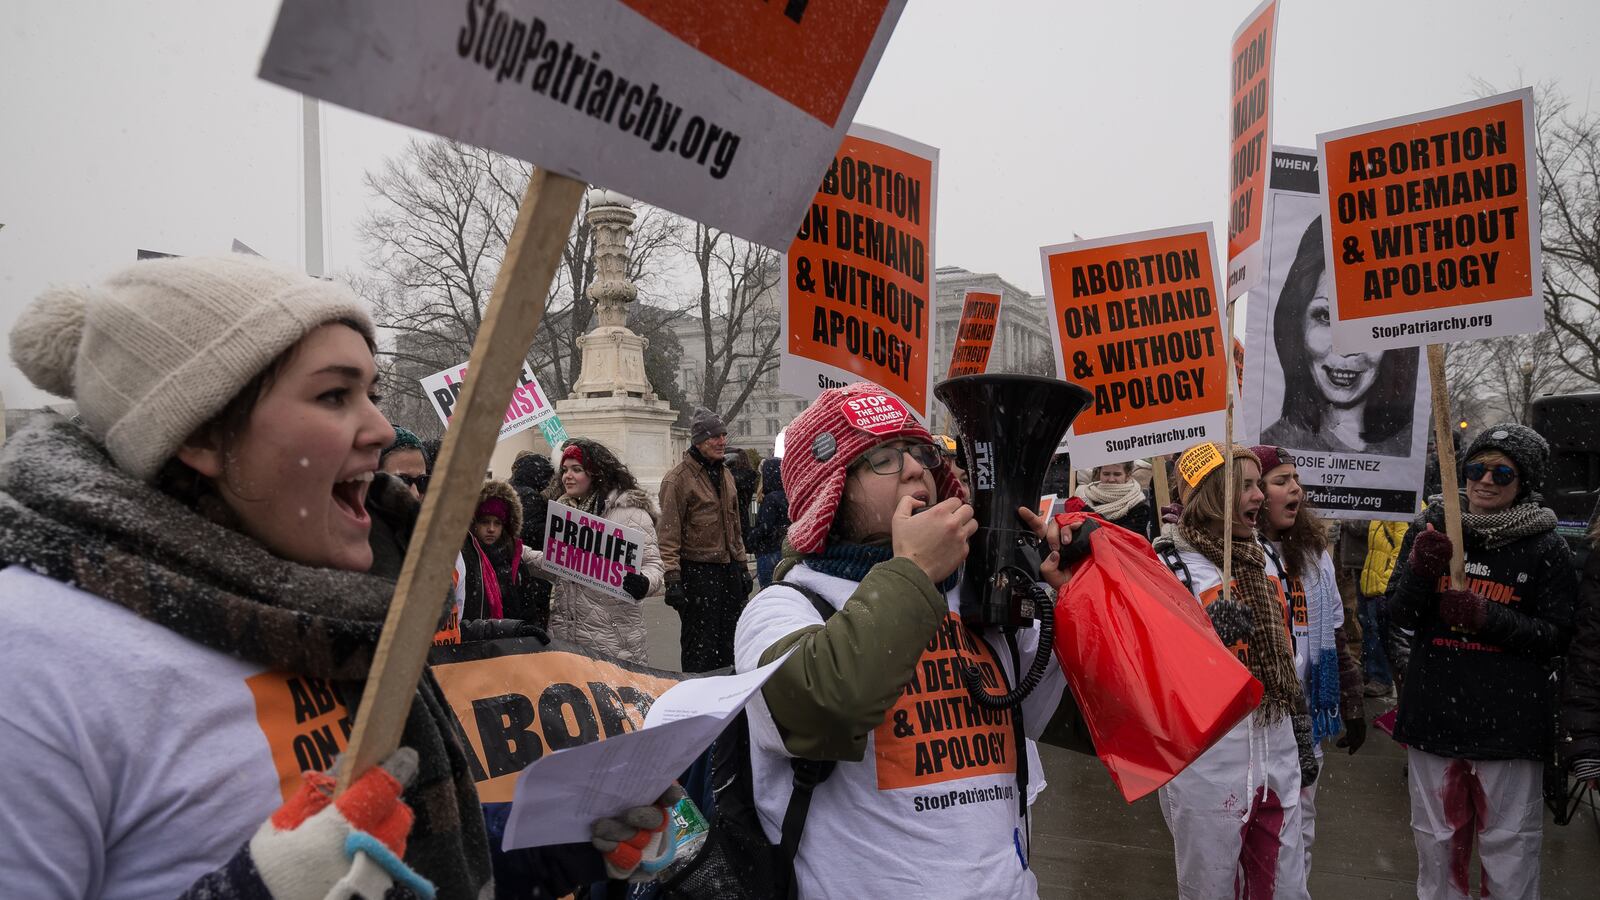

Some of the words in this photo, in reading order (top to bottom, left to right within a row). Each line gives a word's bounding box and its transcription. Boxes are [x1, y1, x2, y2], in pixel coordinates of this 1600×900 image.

[457, 0, 742, 180] StopPatriarchy.org
[1232, 77, 1266, 144] MAND
[1231, 132, 1265, 194] HOUT
[1275, 157, 1310, 172] WHEN
[1348, 120, 1508, 184] ABORTION
[1337, 188, 1378, 225] ON
[1384, 162, 1518, 217] DEMAND
[836, 208, 925, 285] DEMAND
[1342, 235, 1366, 266] &
[1371, 206, 1520, 261] WITHOUT
[795, 256, 816, 294] &
[822, 258, 925, 340] WITHOUT
[1072, 248, 1201, 299] ABORTION
[1363, 251, 1500, 302] APOLOGY
[1064, 303, 1102, 340] ON
[1106, 286, 1213, 333] DEMAND
[1371, 314, 1493, 340] StopPatriarchy.org
[812, 305, 912, 383] APOLOGY
[1072, 350, 1095, 380] &
[1097, 326, 1216, 376] WITHOUT
[848, 394, 887, 411] STOP
[855, 408, 874, 418] THE
[874, 404, 895, 413] WAR
[1095, 367, 1206, 417] APOLOGY
[856, 417, 871, 427] ON
[871, 410, 904, 424] WOMEN
[1105, 425, 1206, 454] StopPatriarchy.org
[974, 439, 990, 490] PYLE
[1320, 473, 1346, 485] 1977
[1328, 457, 1381, 472] JIMENEZ
[549, 513, 639, 569] PROLIFE
[579, 515, 606, 533] AM
[612, 527, 625, 541] A
[1465, 561, 1491, 577] eaks:
[893, 709, 916, 739] &
[915, 732, 1007, 777] APOLOGY
